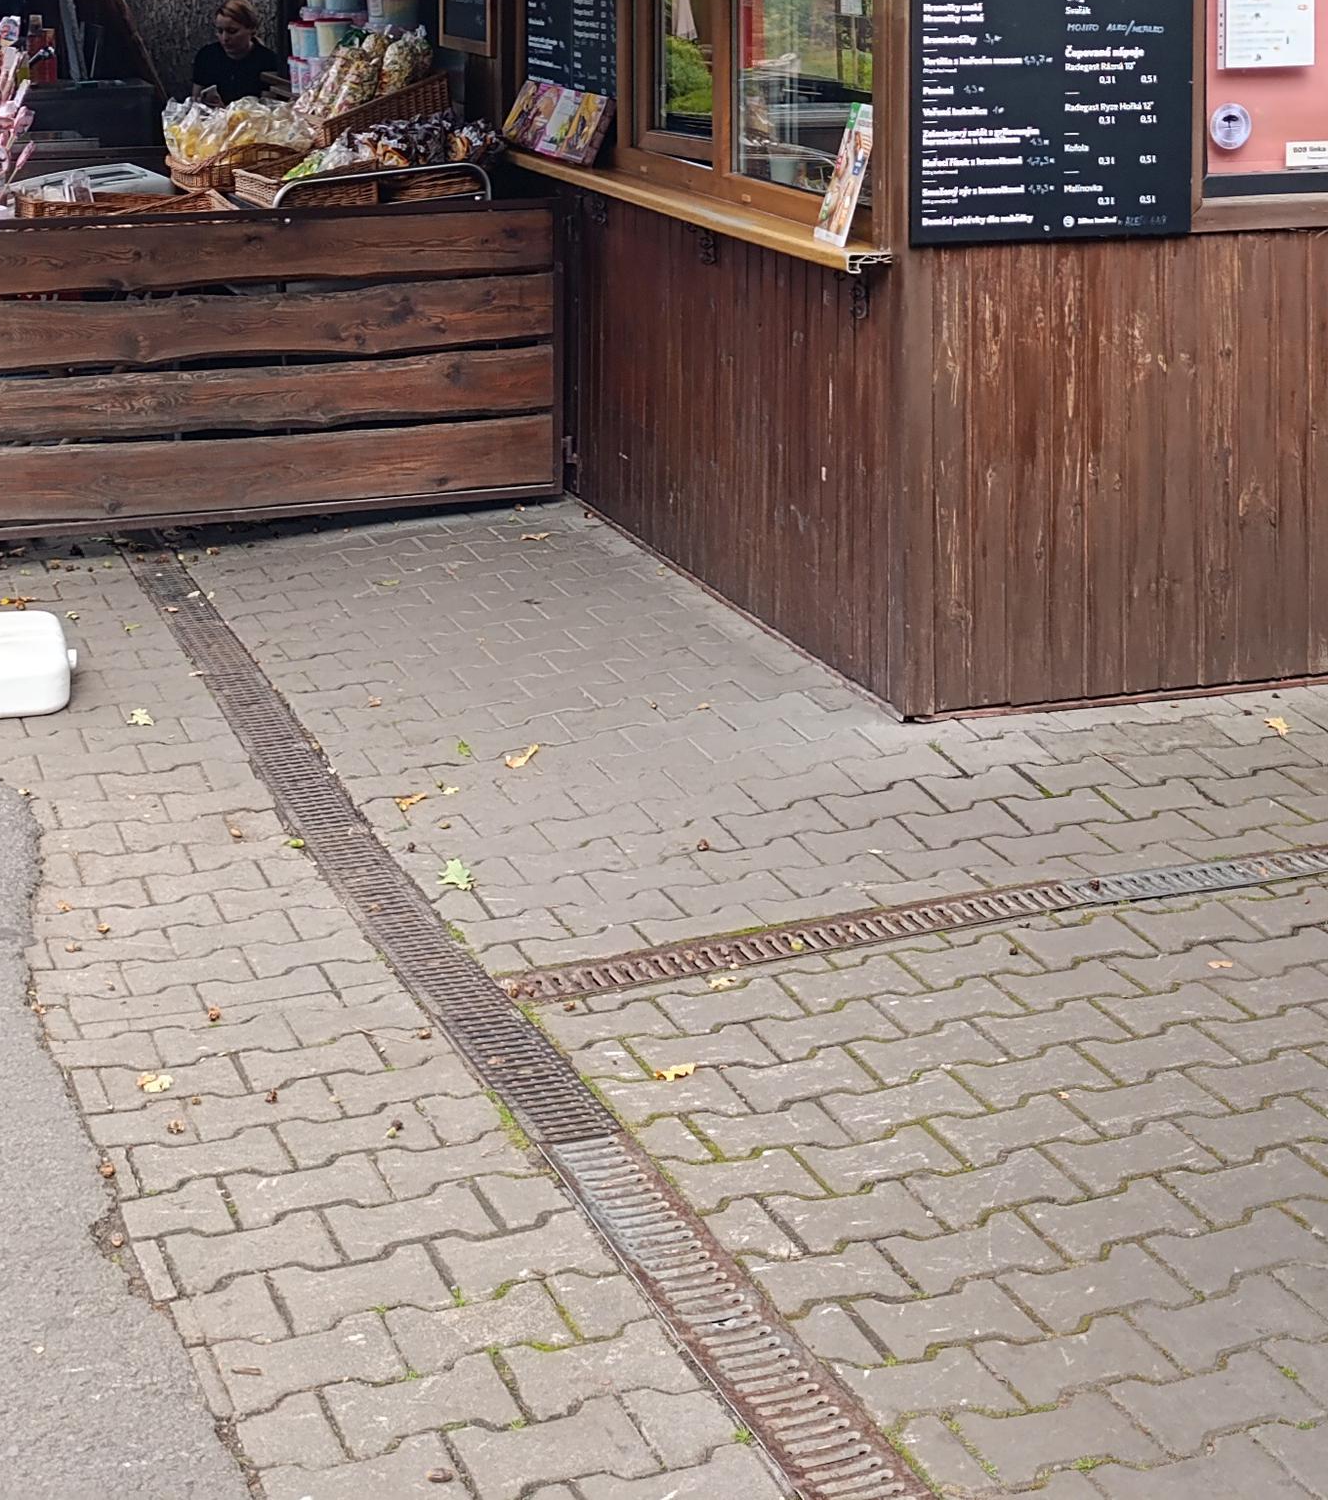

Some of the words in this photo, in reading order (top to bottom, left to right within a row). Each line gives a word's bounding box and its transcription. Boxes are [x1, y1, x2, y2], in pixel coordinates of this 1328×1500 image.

[1065, 62, 1100, 73] Radegast
[1065, 103, 1100, 113] Radegast
[1064, 144, 1090, 152] Kofola
[1064, 184, 1103, 193] Malinovka
